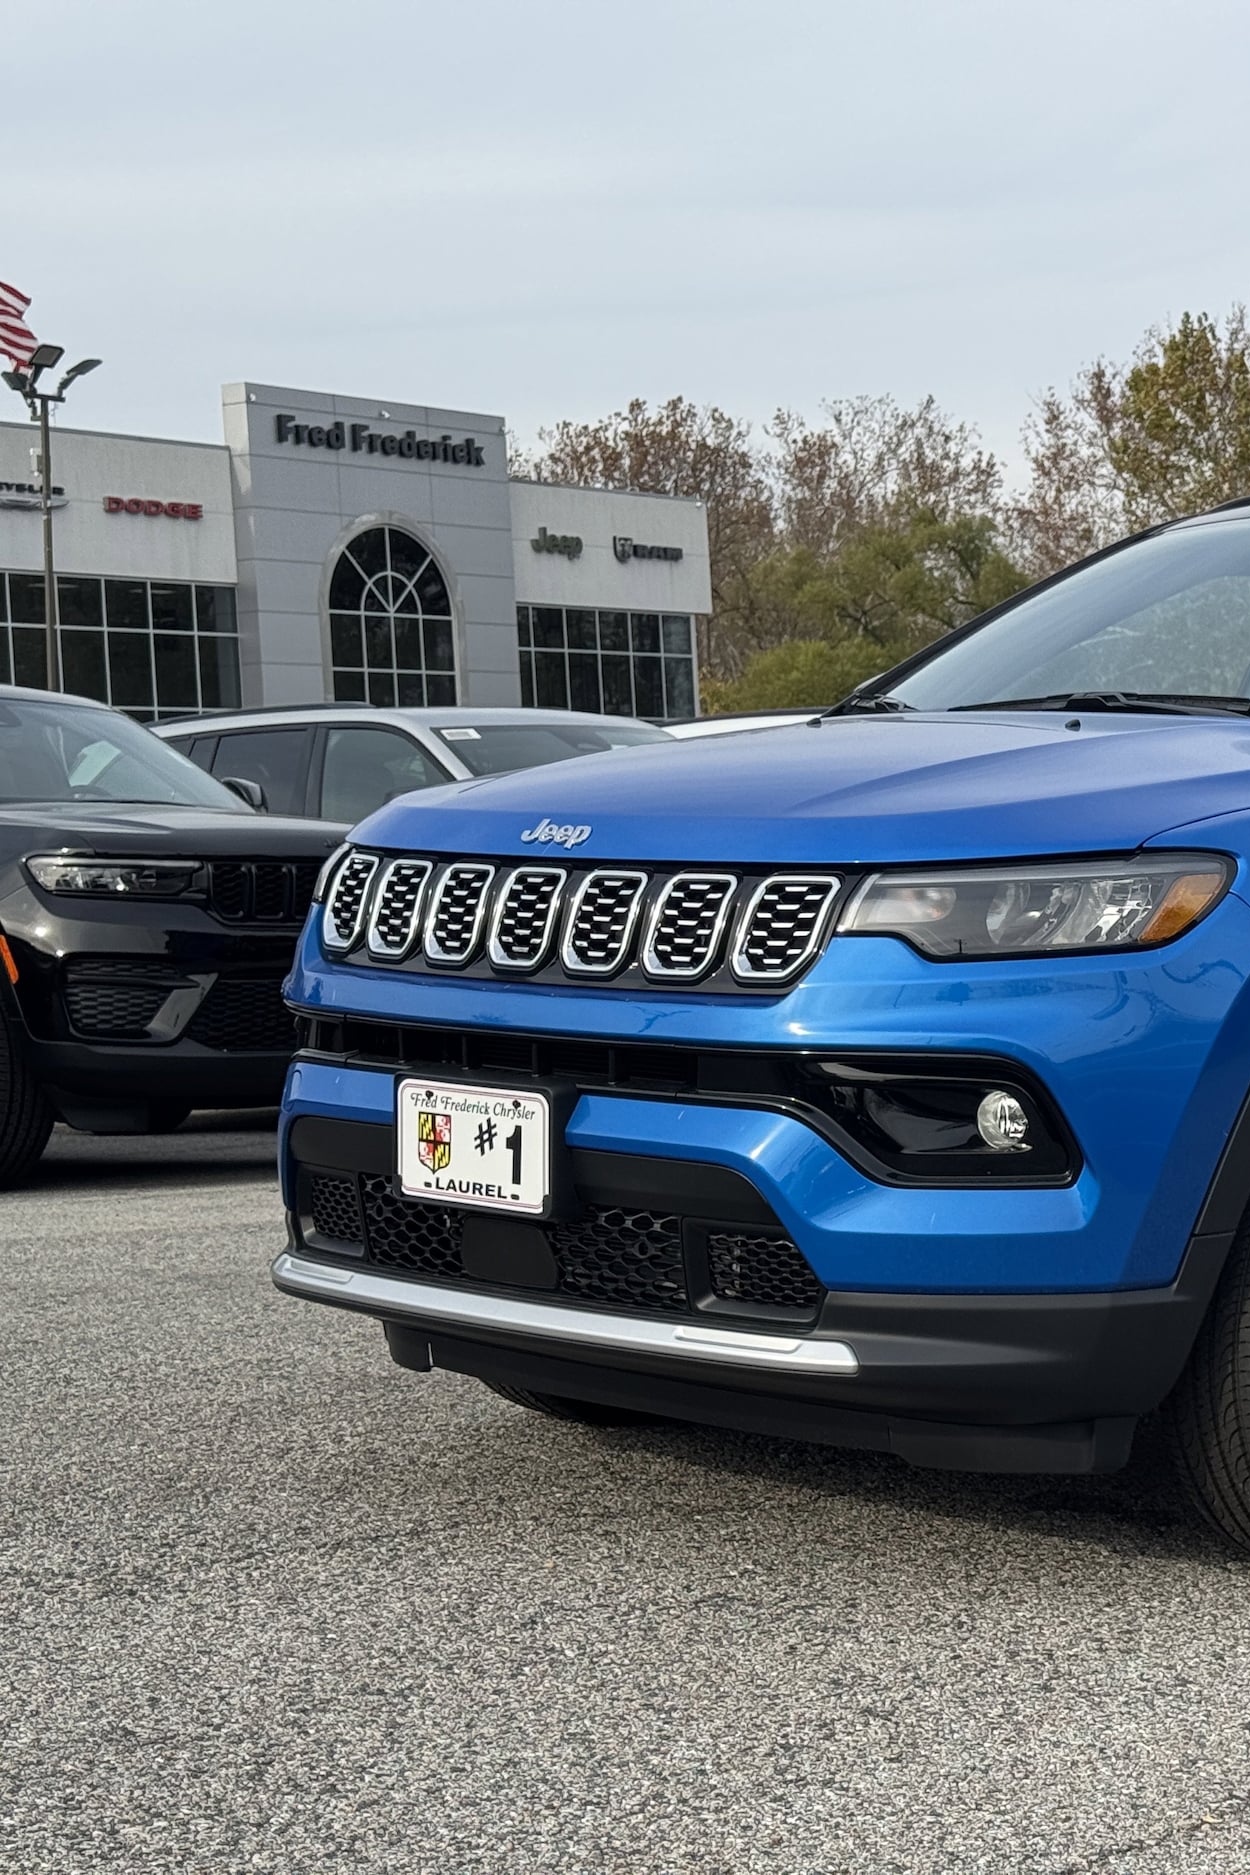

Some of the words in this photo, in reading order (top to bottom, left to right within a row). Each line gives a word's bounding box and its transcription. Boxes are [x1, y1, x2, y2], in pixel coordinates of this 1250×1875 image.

[276, 414, 345, 450] Fred
[350, 423, 485, 466] Frederick
[0, 482, 65, 495] YSLR
[103, 496, 203, 519] DODGE
[531, 527, 583, 560] Jeep
[633, 544, 683, 561] RAM
[521, 818, 592, 849] Jeep
[410, 1092, 437, 1109] Fred
[440, 1096, 490, 1115] Frederick
[493, 1102, 535, 1121] Chrysler
[435, 1177, 507, 1199] LAUREL
